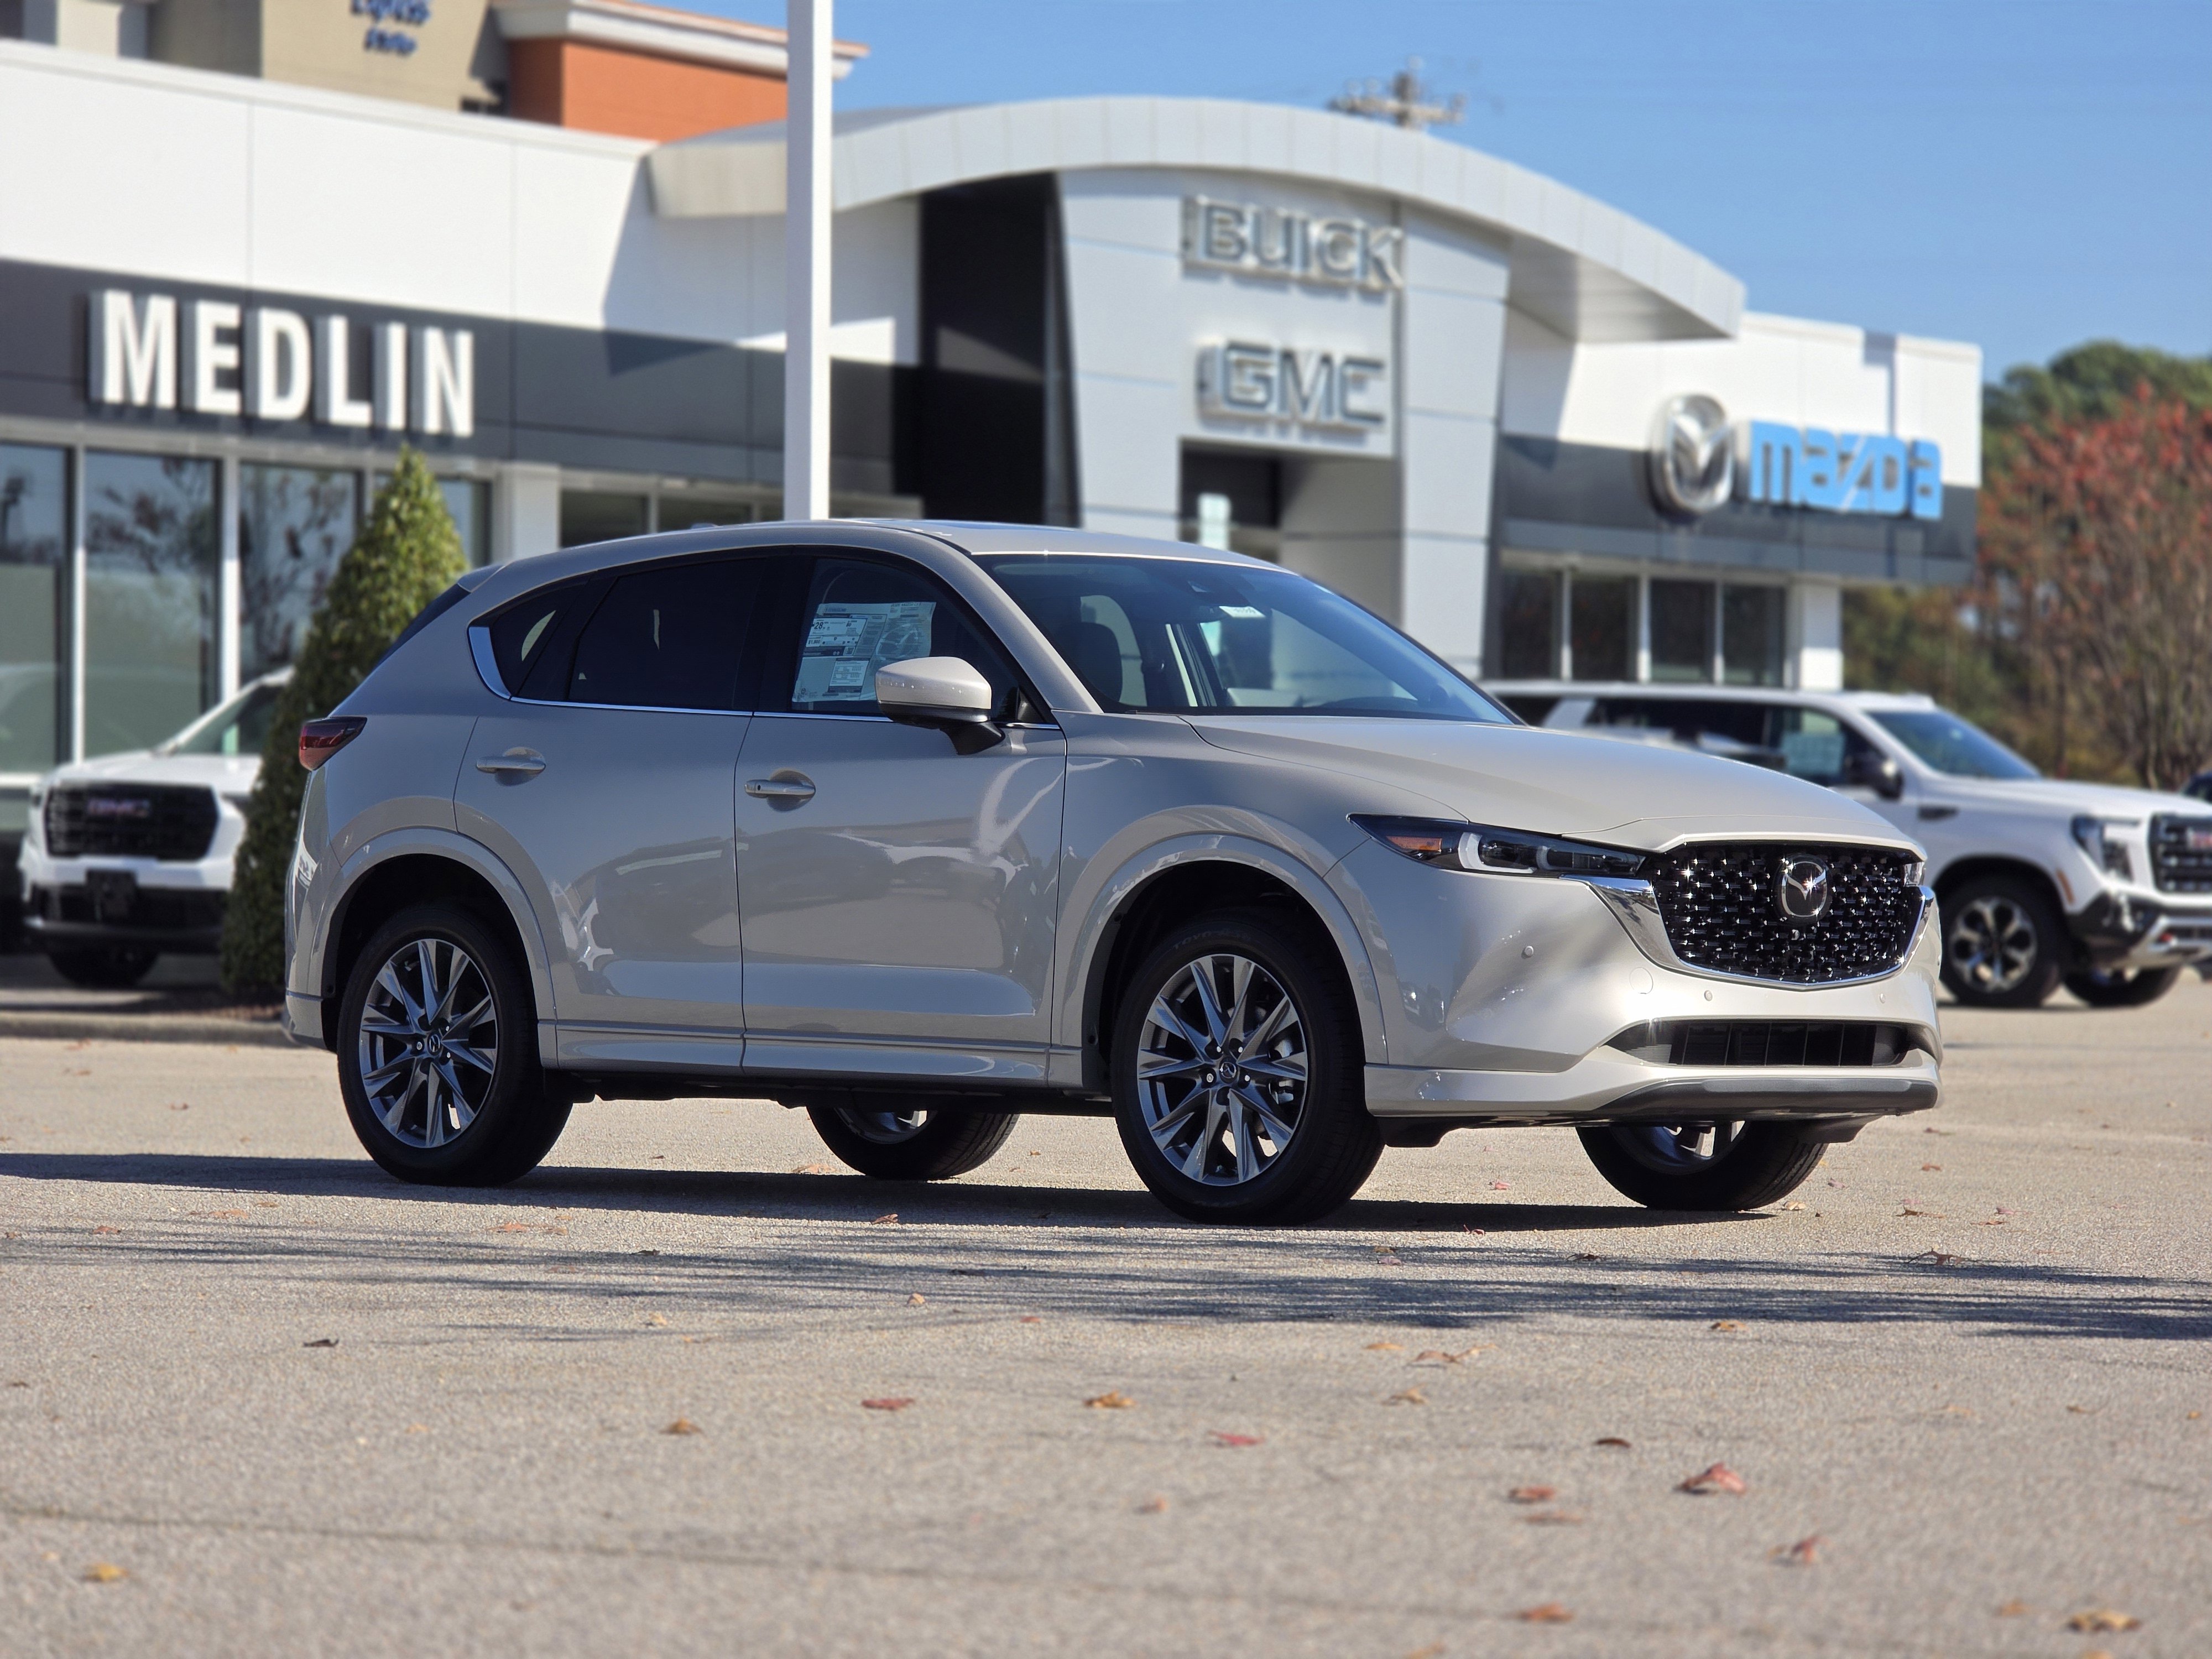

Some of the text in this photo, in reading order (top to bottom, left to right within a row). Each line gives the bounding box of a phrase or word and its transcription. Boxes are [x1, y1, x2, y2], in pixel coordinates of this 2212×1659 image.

[1190, 195, 1405, 290] BUICK
[92, 289, 474, 437] MEDLIN
[1219, 339, 1386, 425] GMC
[814, 622, 824, 630] 28
